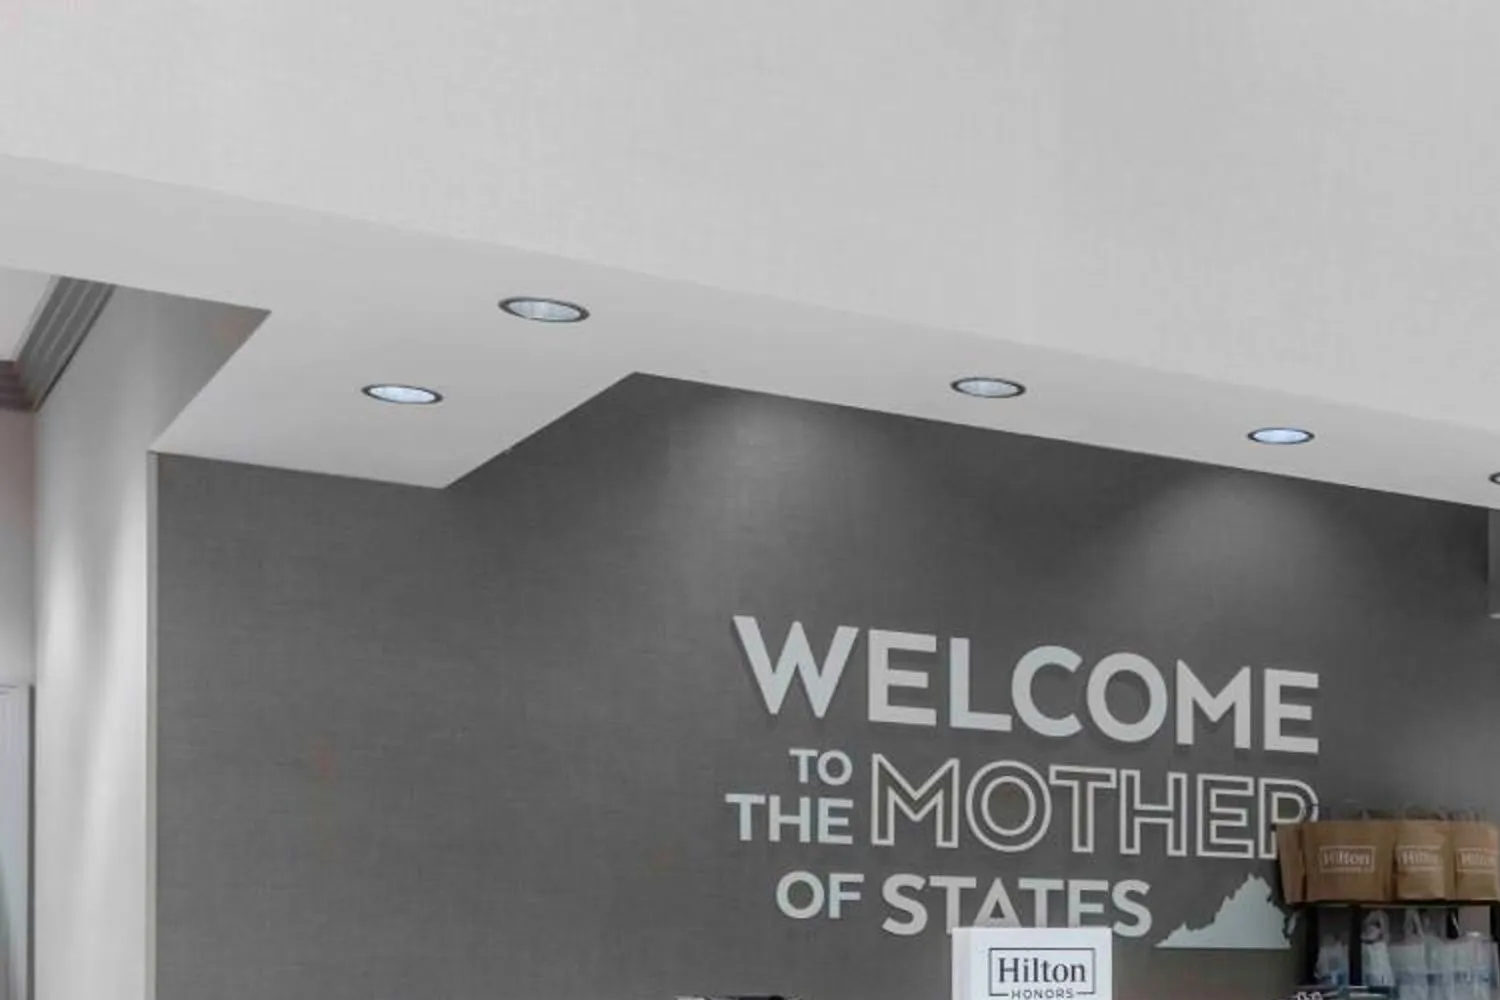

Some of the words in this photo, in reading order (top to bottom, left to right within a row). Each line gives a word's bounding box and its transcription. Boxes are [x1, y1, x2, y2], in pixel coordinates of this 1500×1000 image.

[733, 615, 1319, 754] WELCOME
[789, 748, 852, 786] TO
[725, 793, 853, 844] THE
[871, 753, 1319, 859] MOTHER
[776, 871, 864, 919] OF
[882, 874, 1152, 937] STATES
[998, 957, 1087, 983] Hilton
[1011, 987, 1075, 999] HONORS
